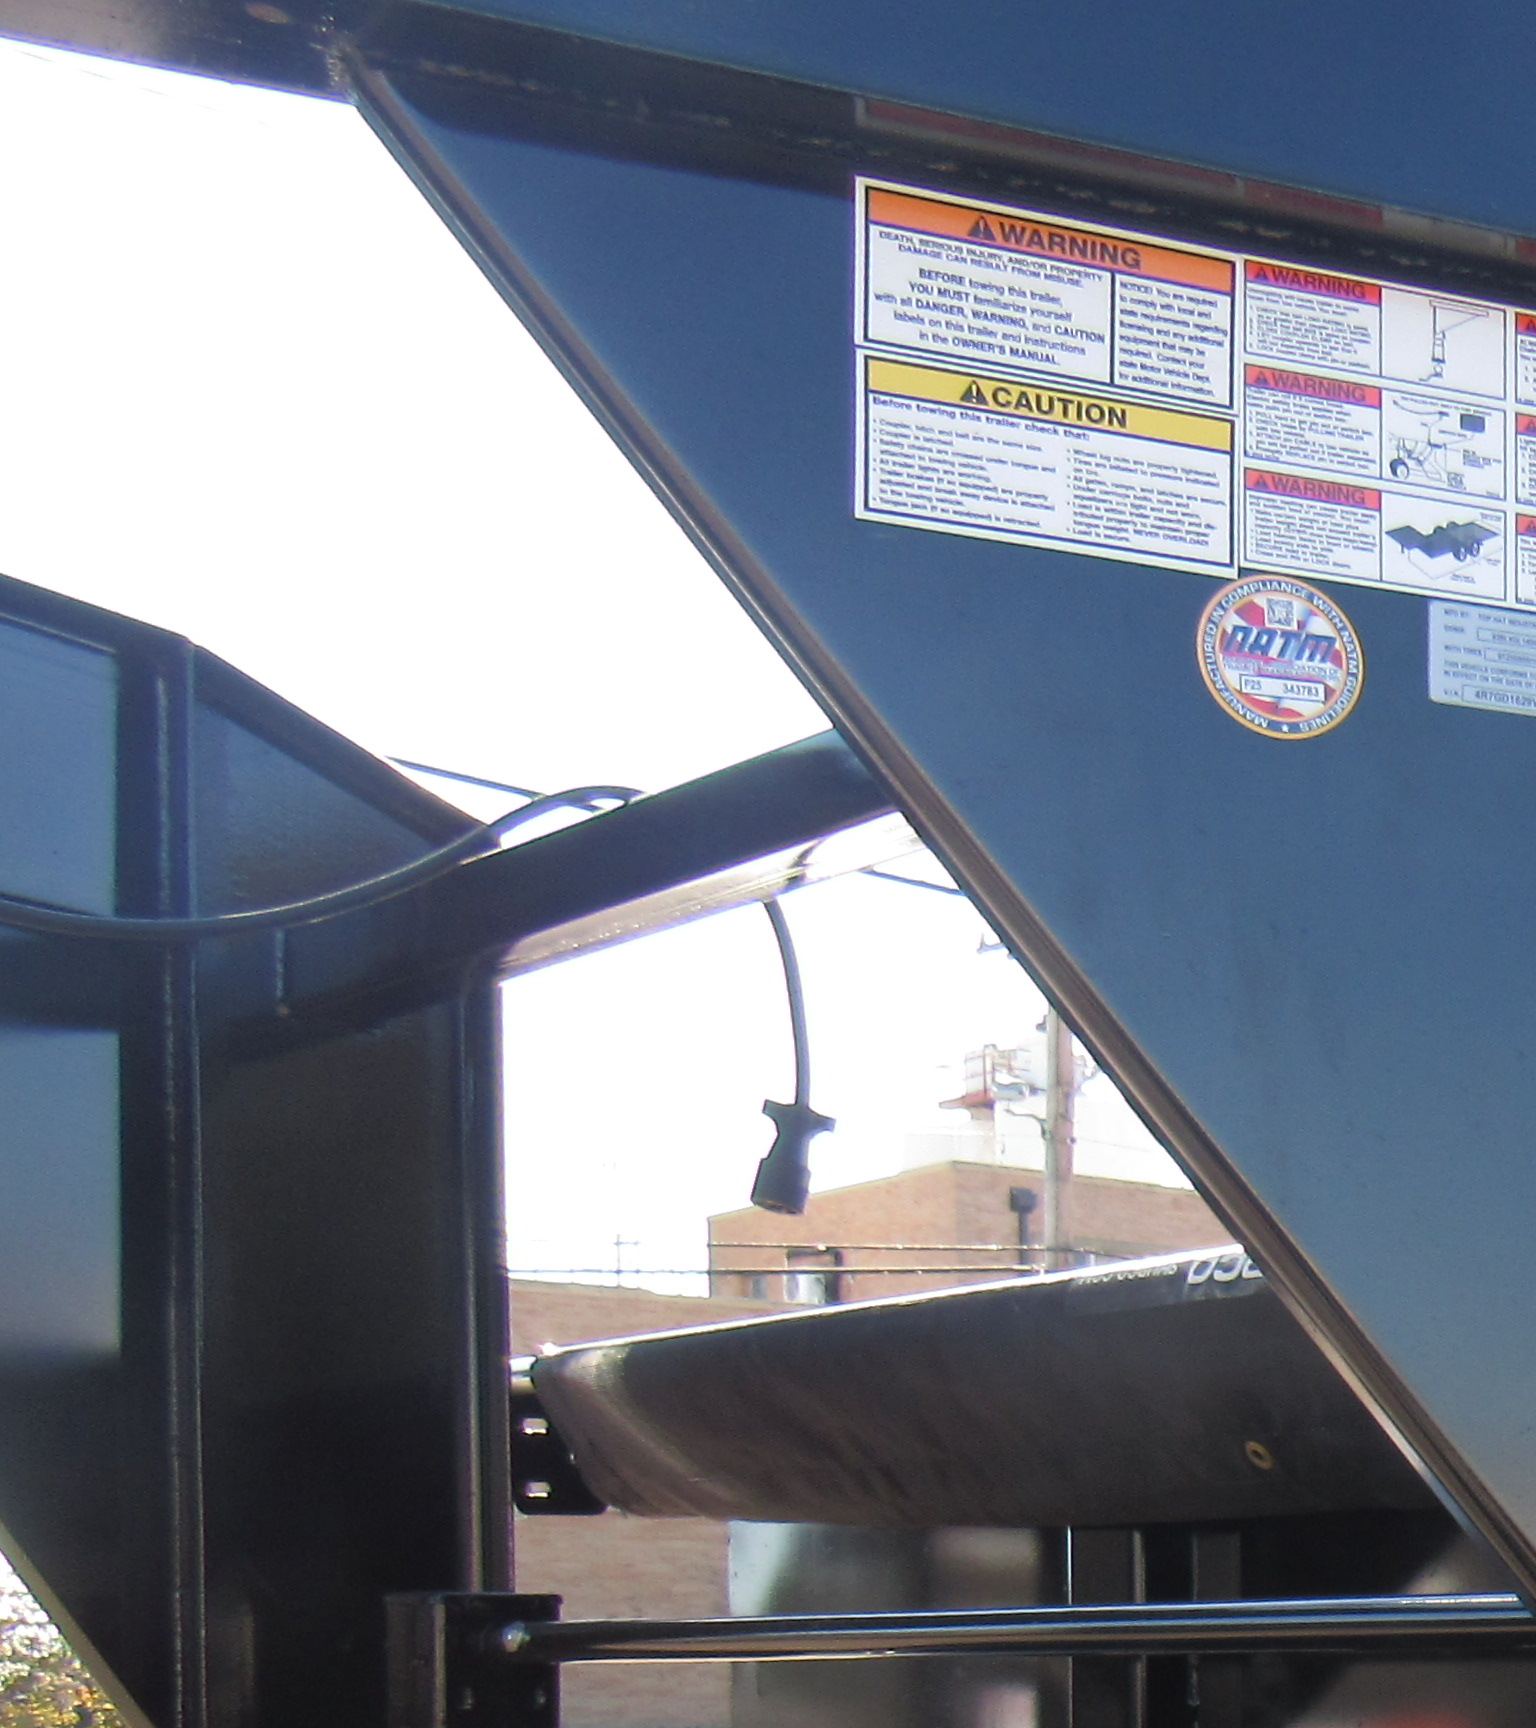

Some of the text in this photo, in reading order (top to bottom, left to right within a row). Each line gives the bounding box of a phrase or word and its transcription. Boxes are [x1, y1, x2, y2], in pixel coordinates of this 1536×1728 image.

[1000, 221, 1141, 270] WARNING
[909, 281, 1071, 323] YOU MUST familiarize yourself
[919, 268, 1062, 307] BEFORE towing this trailer,
[1272, 269, 1366, 300] WARNING
[874, 291, 1105, 343] with all DANGER, WARNING, and CAUTION
[893, 310, 1085, 355] labels on this trailer and instructions
[919, 330, 1059, 365] in the OWNER'S MANUAL.
[1272, 370, 1366, 402] WARNING
[873, 396, 1089, 440] Before towing this trailer check that:
[992, 387, 1128, 428] CAUTION
[1272, 474, 1366, 506] WARNING
[1222, 580, 1308, 607] COMPLIANCE
[1313, 595, 1344, 628] WITH
[1224, 624, 1338, 664] NATM
[1204, 625, 1269, 728] MANUFACTURED
[1299, 676, 1357, 732] GUIDELINES
